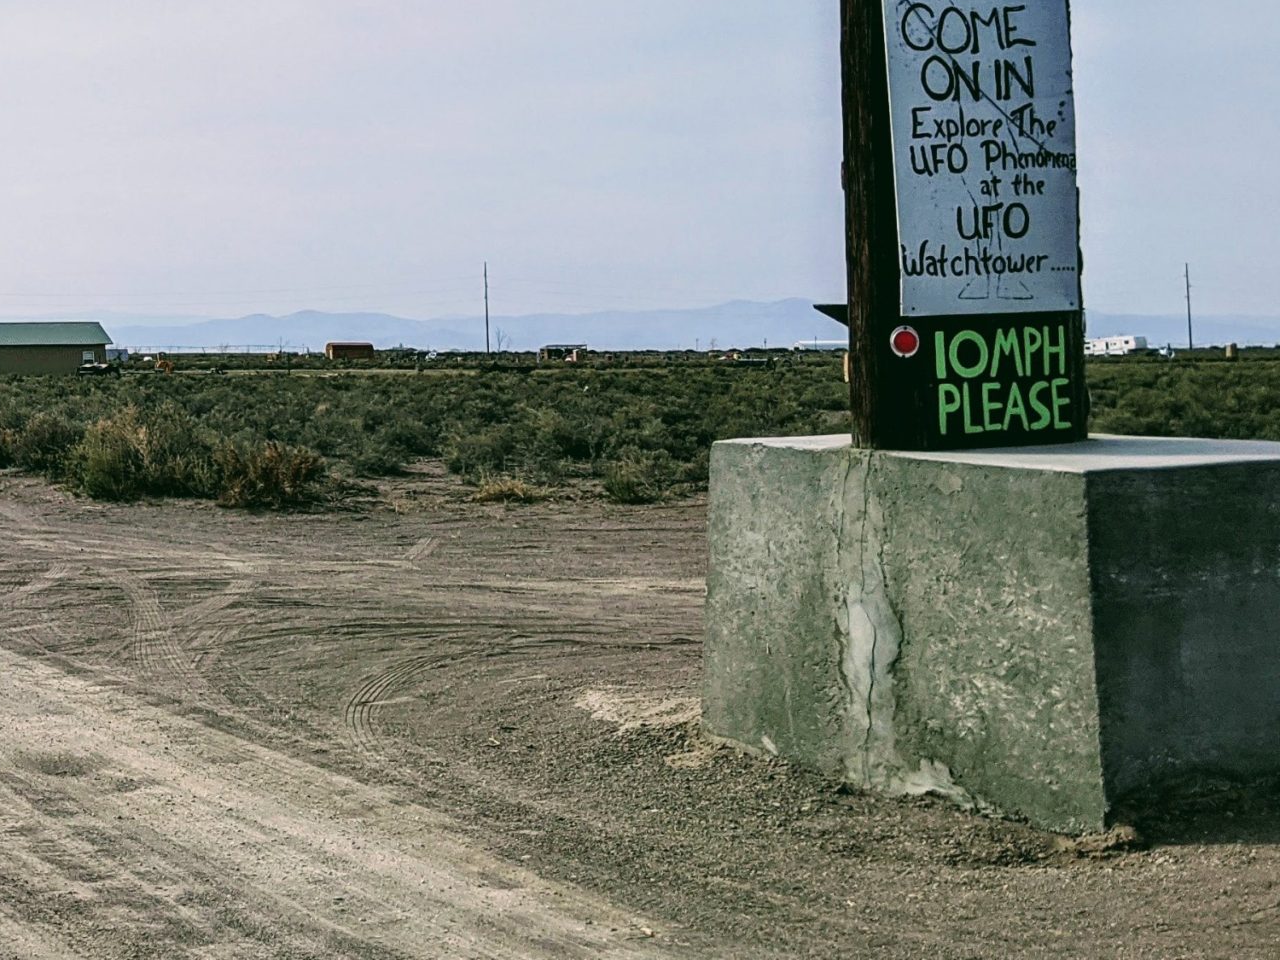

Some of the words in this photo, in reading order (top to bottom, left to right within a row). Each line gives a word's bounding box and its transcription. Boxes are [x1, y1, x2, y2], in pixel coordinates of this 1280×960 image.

[901, 3, 1036, 54] COME
[921, 55, 980, 101] ON
[994, 55, 1035, 101] IN
[912, 107, 1003, 140] Explore
[1011, 102, 1056, 138] The
[910, 142, 968, 176] UFO
[980, 176, 1001, 197] at
[1011, 173, 1045, 196] the
[957, 202, 1030, 240] UFO
[938, 378, 1072, 435] PLEASE
